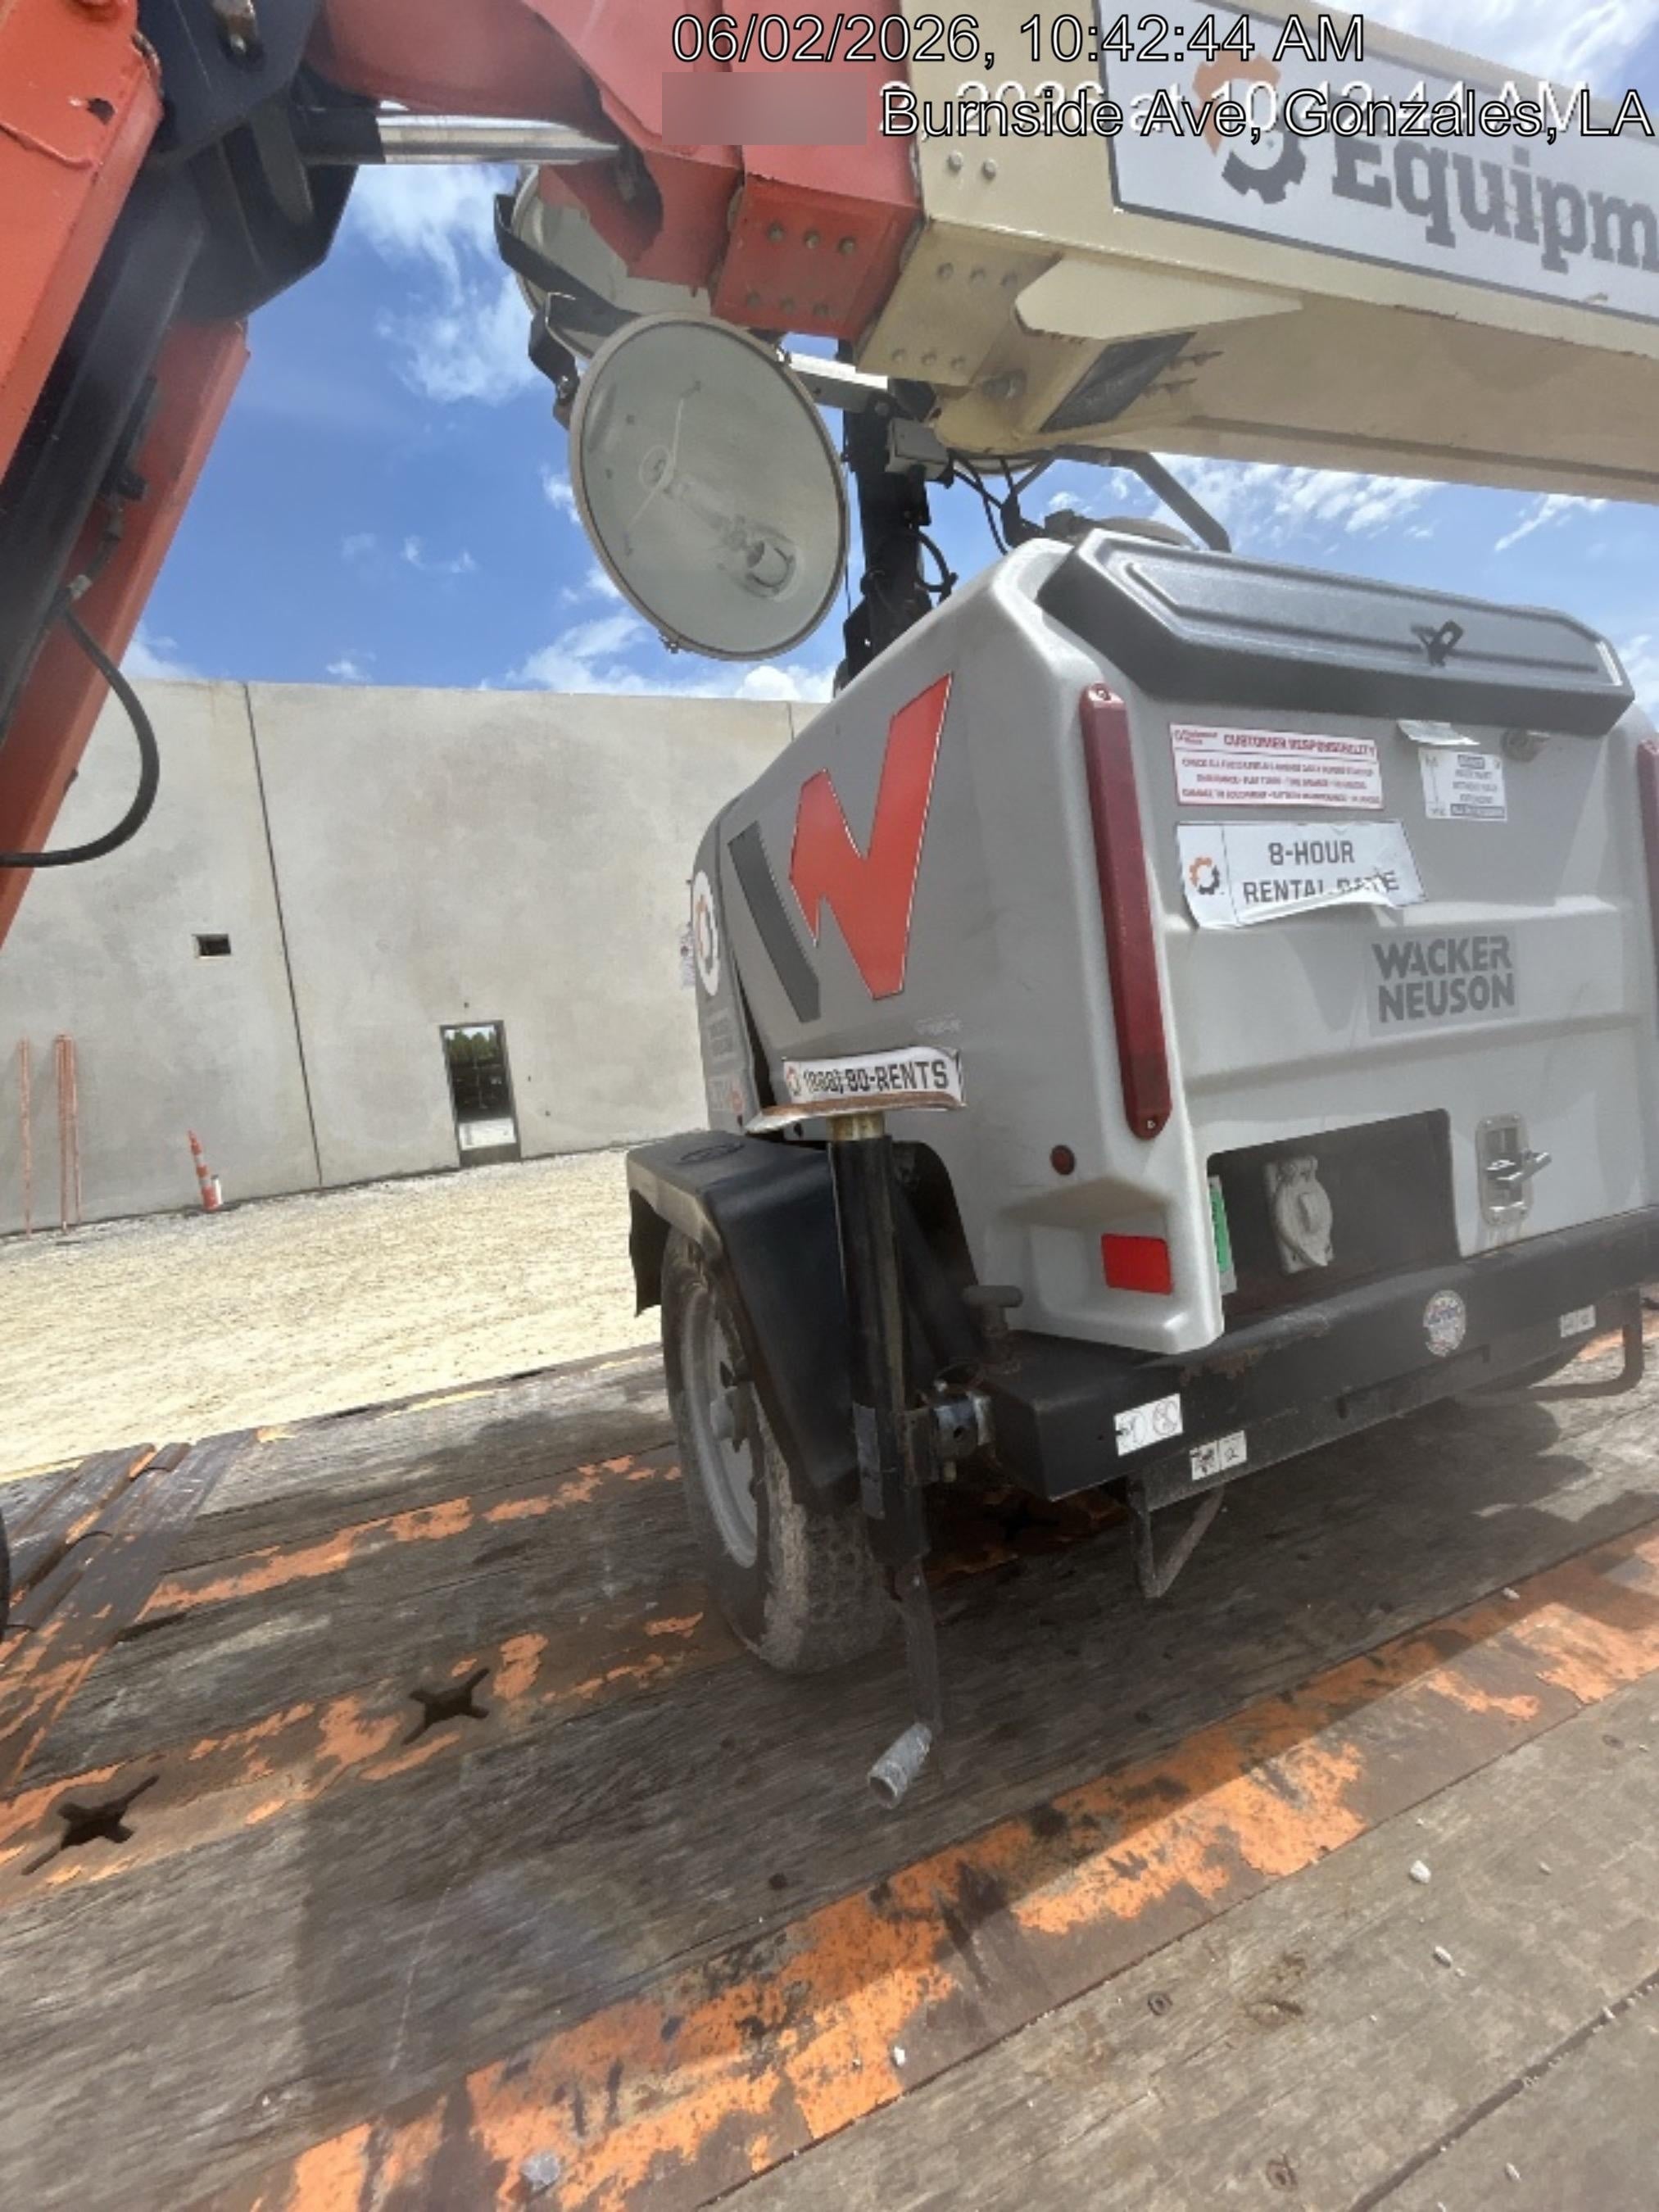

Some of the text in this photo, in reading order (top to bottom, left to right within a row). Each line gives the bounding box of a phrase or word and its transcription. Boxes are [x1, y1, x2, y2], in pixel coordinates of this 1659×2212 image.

[1331, 135, 1659, 274] Equipm
[1267, 840, 1355, 866] 8-HOUR
[1371, 935, 1513, 981] WACKER
[1377, 972, 1516, 1023] NEUSON
